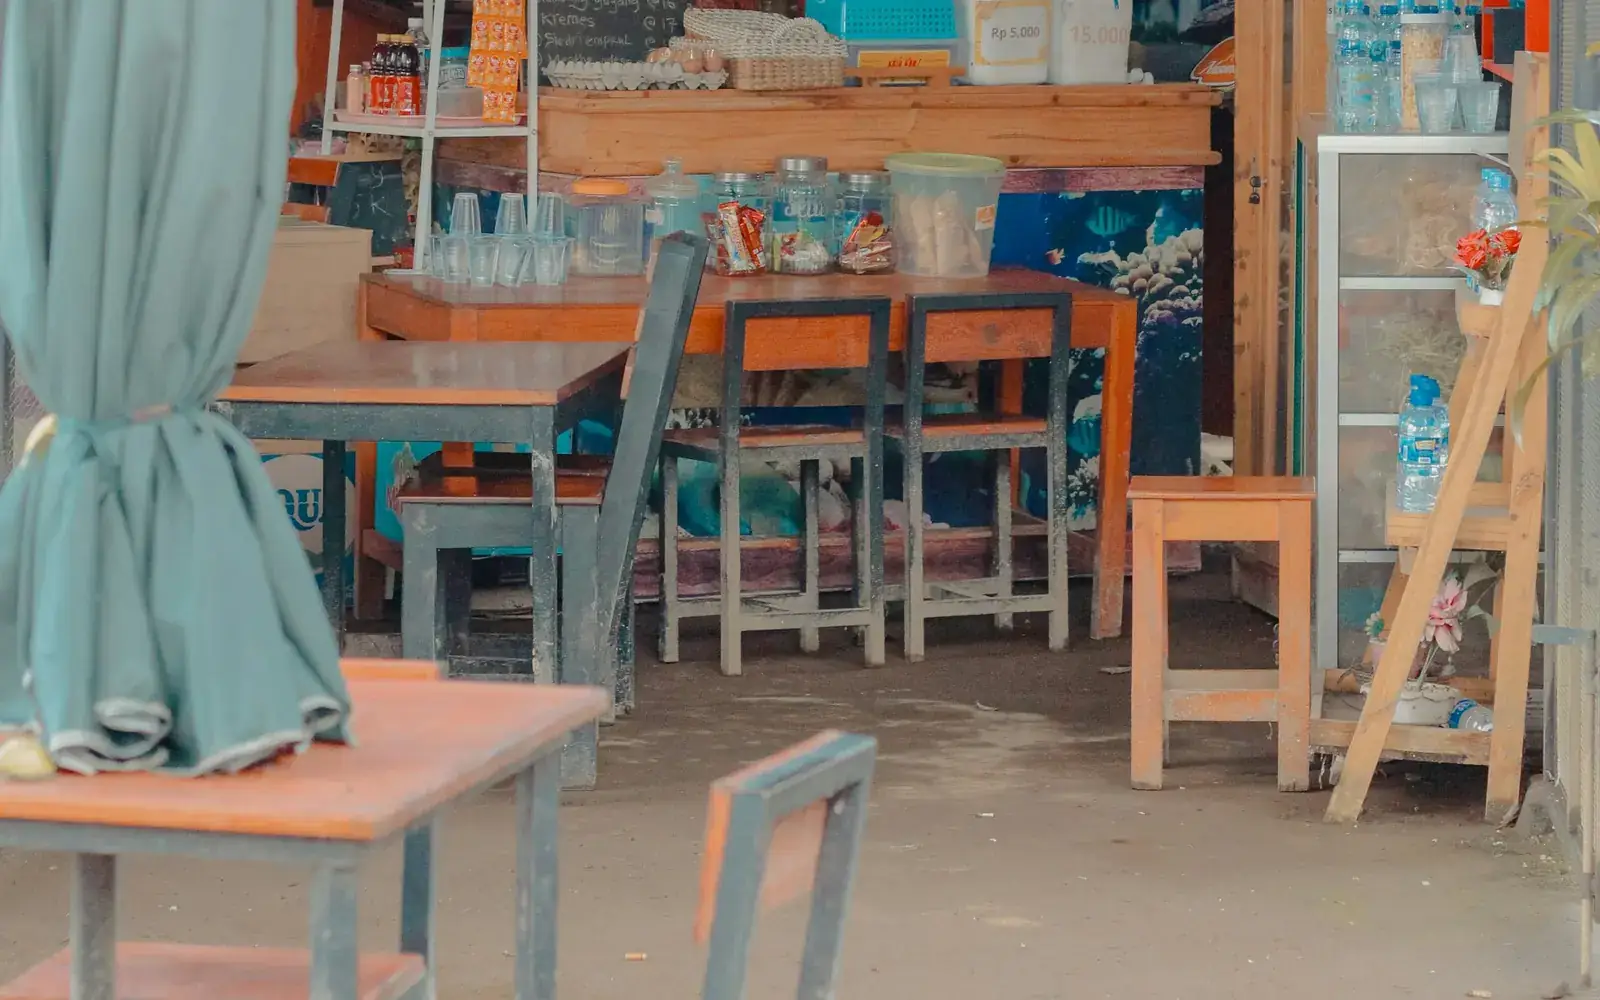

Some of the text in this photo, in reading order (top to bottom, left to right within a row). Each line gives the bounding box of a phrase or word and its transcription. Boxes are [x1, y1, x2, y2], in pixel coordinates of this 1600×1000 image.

[991, 26, 1041, 39] Rp 5.000
[1069, 25, 1129, 45] 15.000
